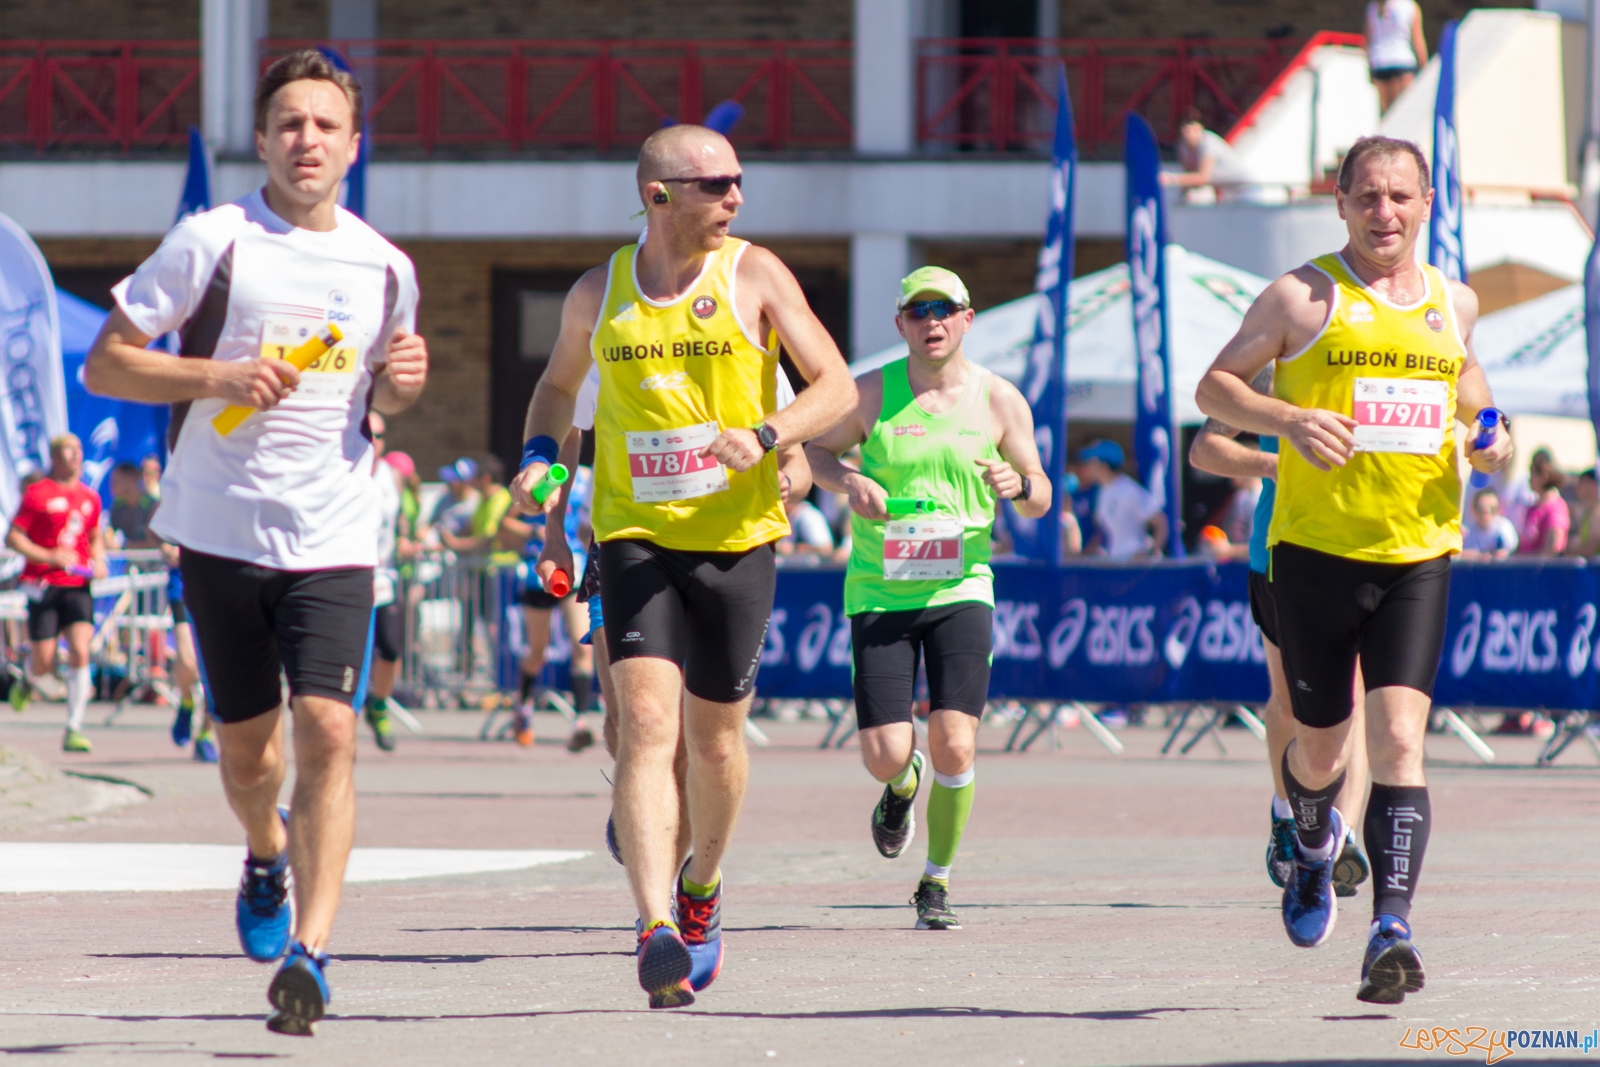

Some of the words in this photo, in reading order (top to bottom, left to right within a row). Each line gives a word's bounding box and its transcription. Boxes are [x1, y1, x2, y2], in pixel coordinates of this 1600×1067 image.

[602, 340, 664, 362] LUBOŃ
[672, 340, 734, 358] BIEGA
[1327, 348, 1398, 366] LUBOŃ
[1405, 353, 1455, 377] BIEGA
[1366, 402, 1432, 427] 179/1
[638, 449, 705, 475] 178/1
[898, 540, 943, 559] 27/1
[1086, 605, 1155, 665] asics
[1482, 609, 1558, 672] asics
